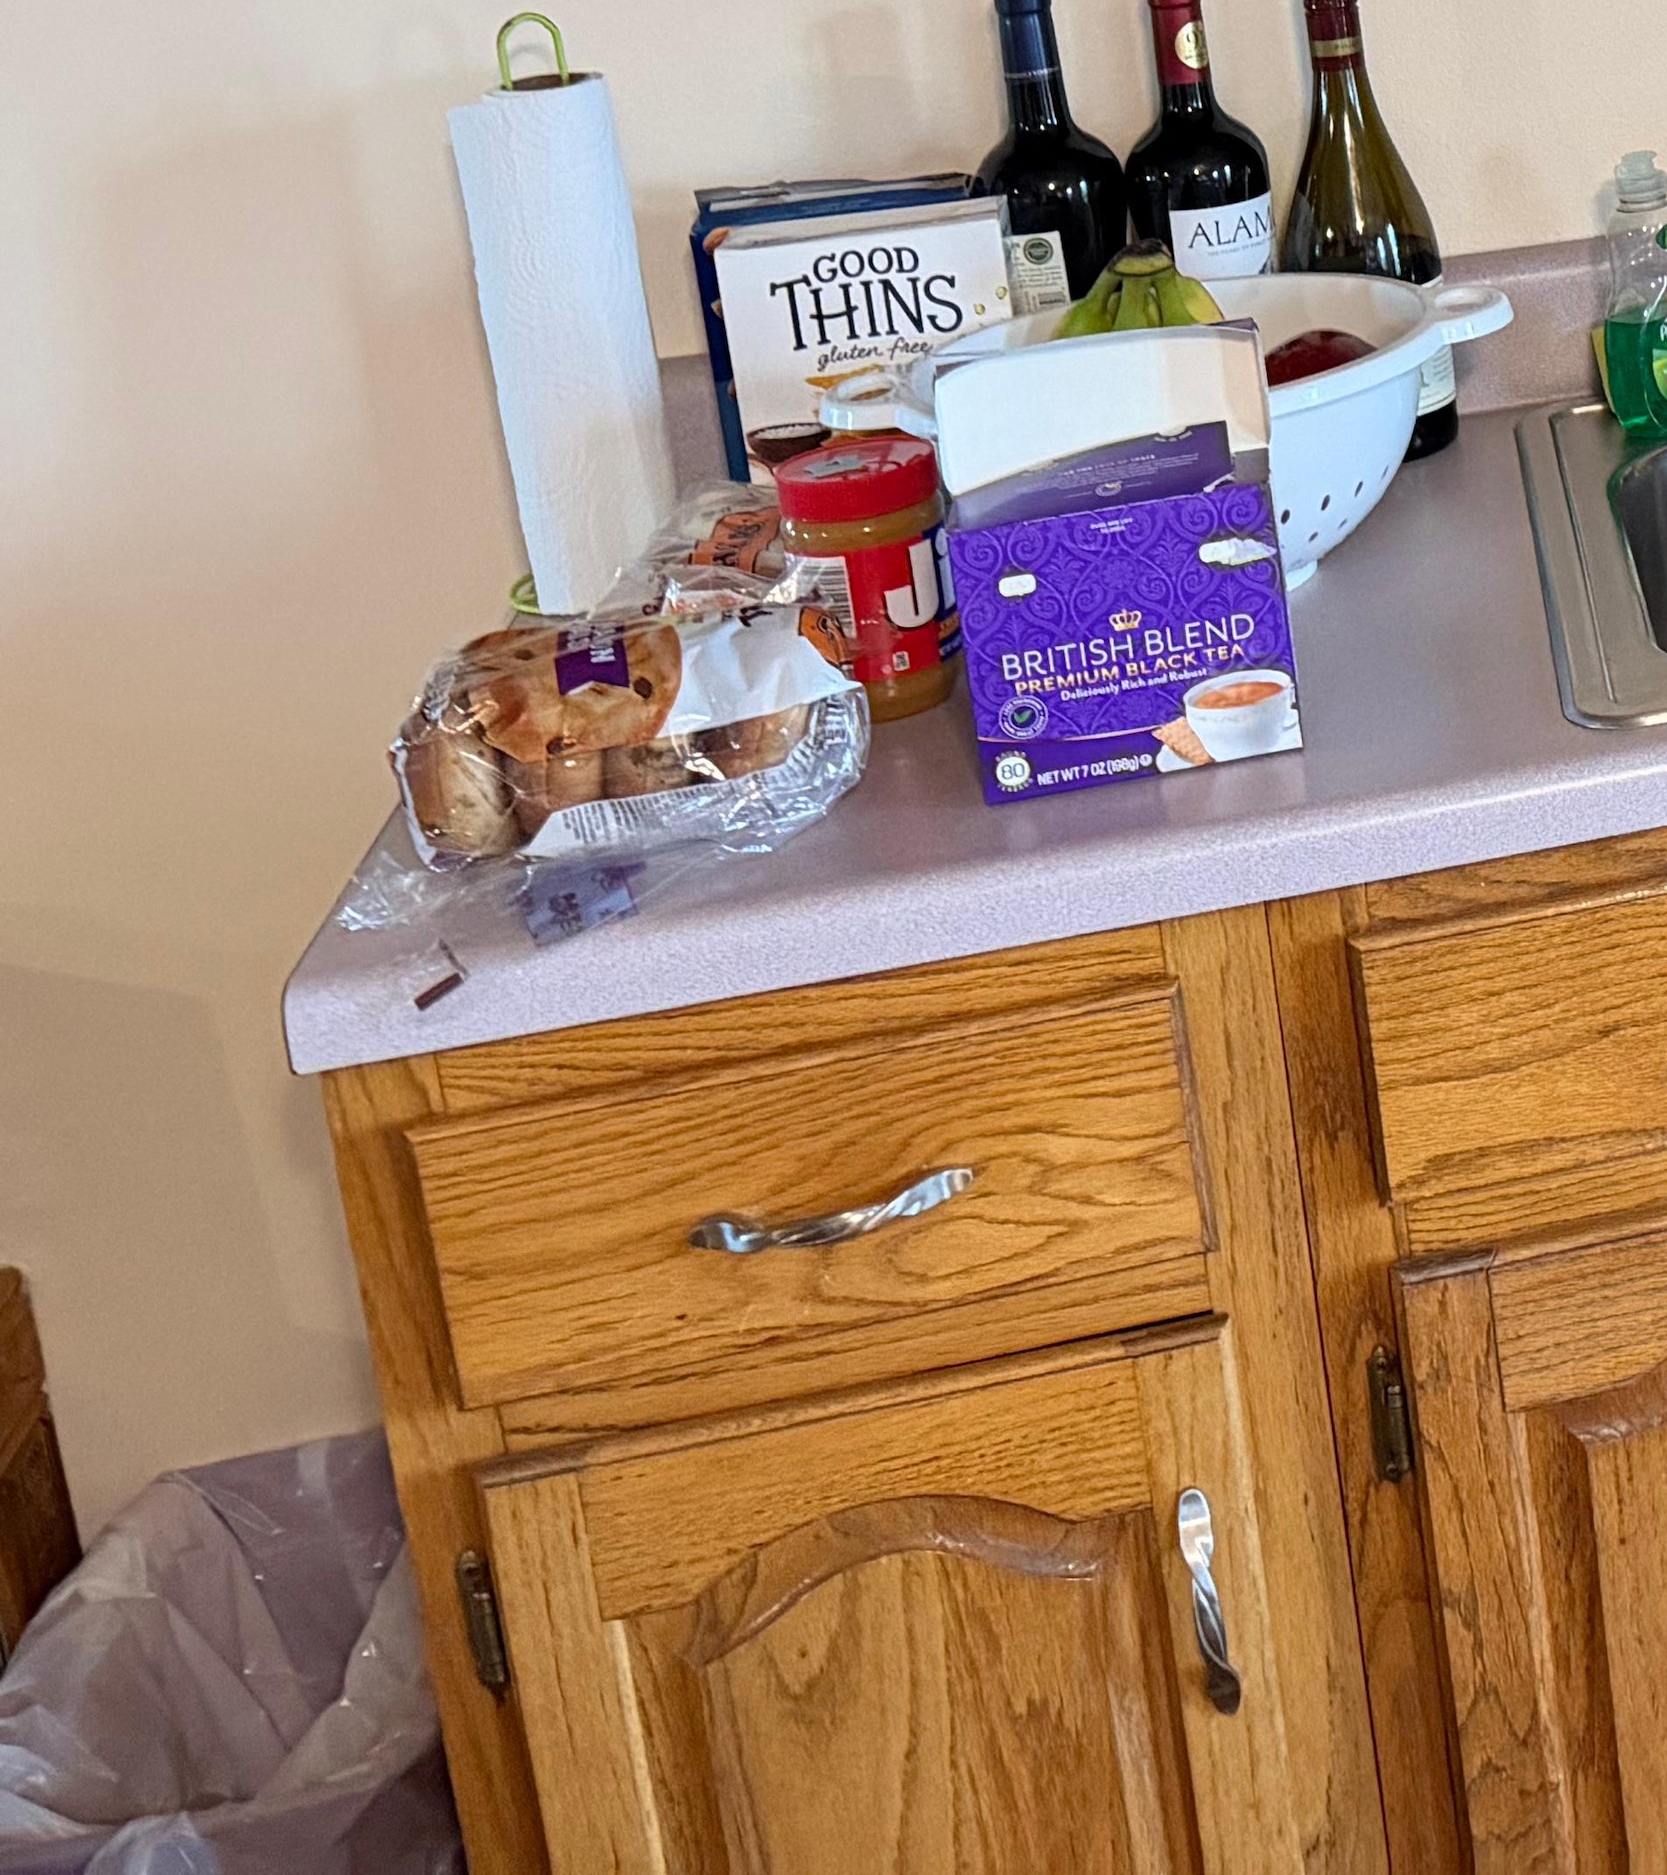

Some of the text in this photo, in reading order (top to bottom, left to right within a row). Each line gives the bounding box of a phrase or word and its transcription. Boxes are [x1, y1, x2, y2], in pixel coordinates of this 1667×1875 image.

[813, 246, 919, 283] GOOD
[770, 274, 963, 351] THINS
[816, 336, 934, 372] gluten free
[1002, 633, 1135, 681] BRITISH
[1145, 613, 1255, 656] BLEND
[1015, 643, 1245, 696] PREMIUM BLACK TEA
[1061, 667, 1208, 702] Deliciously Rich and Robust
[1001, 762, 1026, 781] 80
[1037, 769, 1060, 786] NET
[1060, 765, 1081, 782] WT
[1081, 764, 1089, 778] 7
[1090, 761, 1106, 777] OZ
